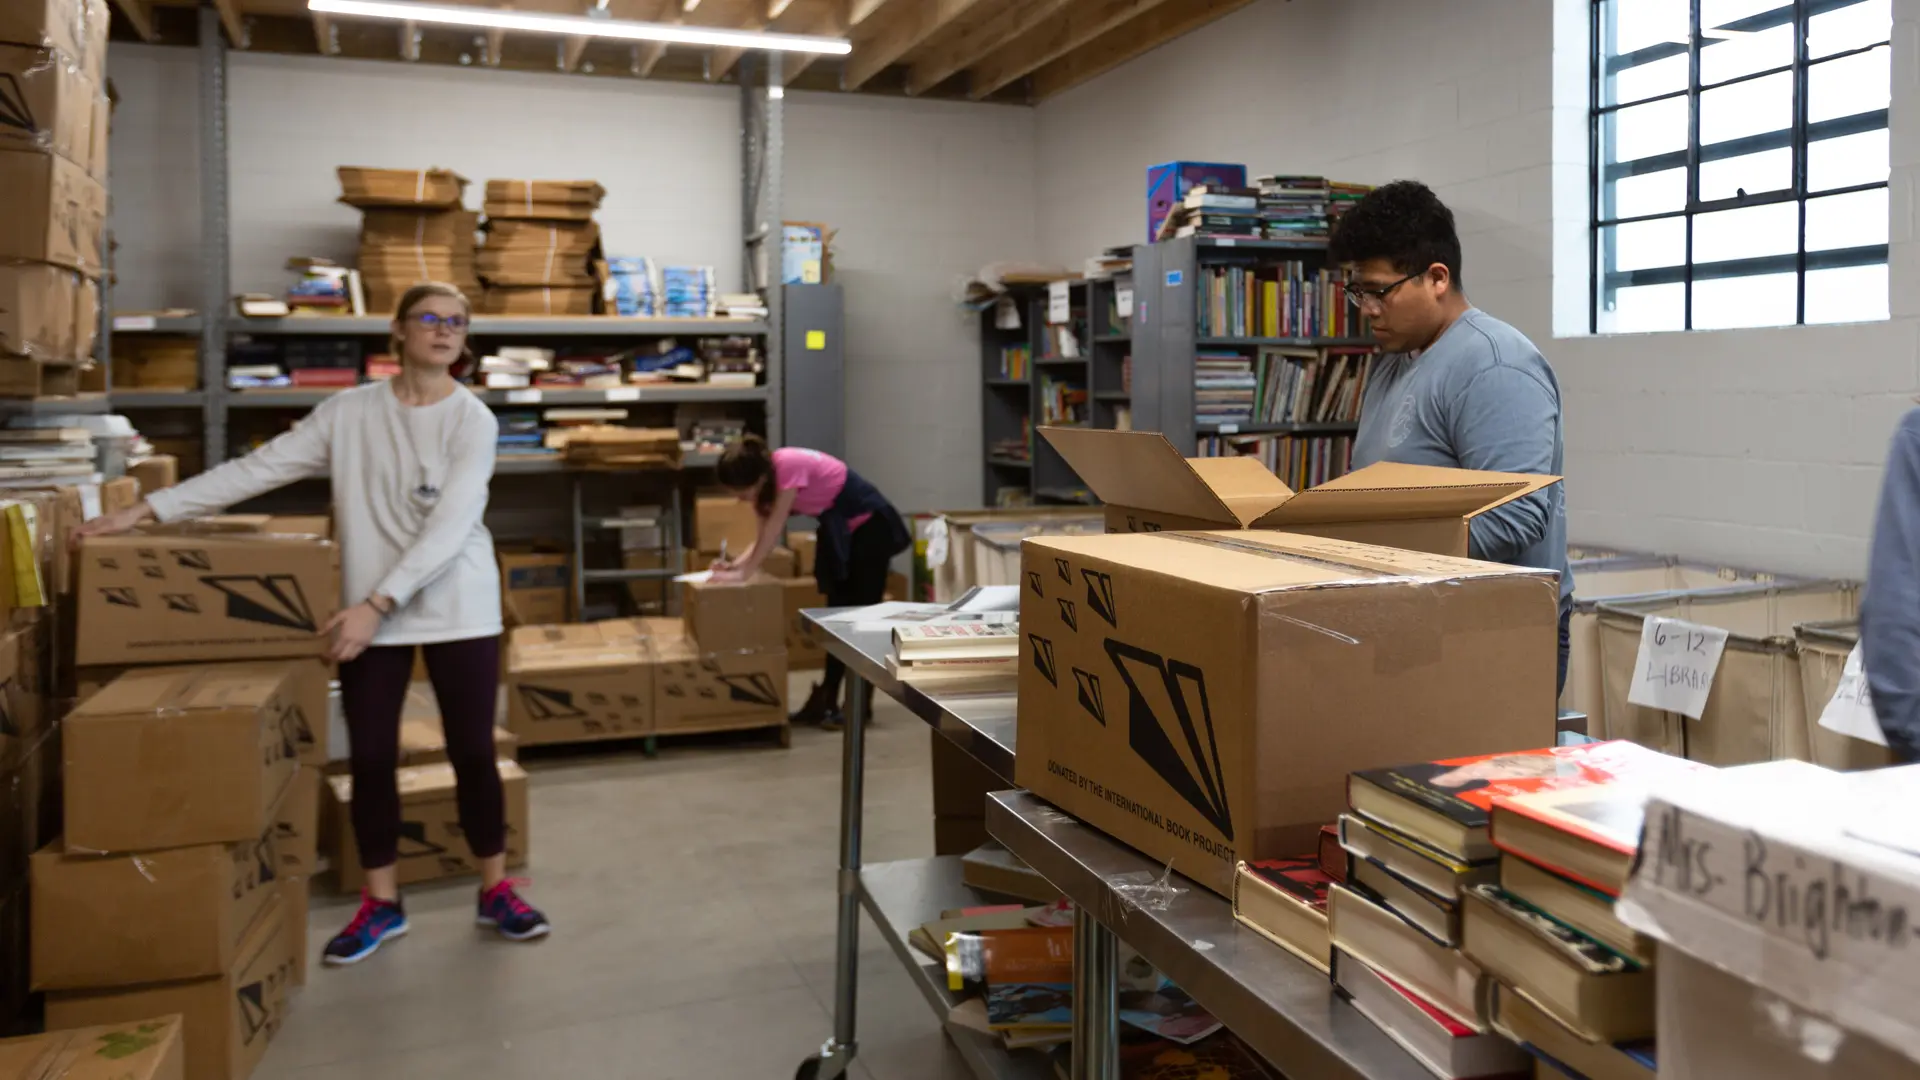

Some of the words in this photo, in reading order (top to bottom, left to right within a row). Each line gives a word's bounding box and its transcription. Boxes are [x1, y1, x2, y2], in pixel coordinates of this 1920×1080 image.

[1654, 622, 1706, 656] 6-12
[1047, 759, 1078, 785] DONATED
[1079, 775, 1088, 791] BY
[1089, 780, 1104, 799] THE
[1104, 787, 1165, 830] INTERNATIONAL
[1166, 818, 1191, 843] BOOK
[1193, 831, 1236, 865] PROJECT
